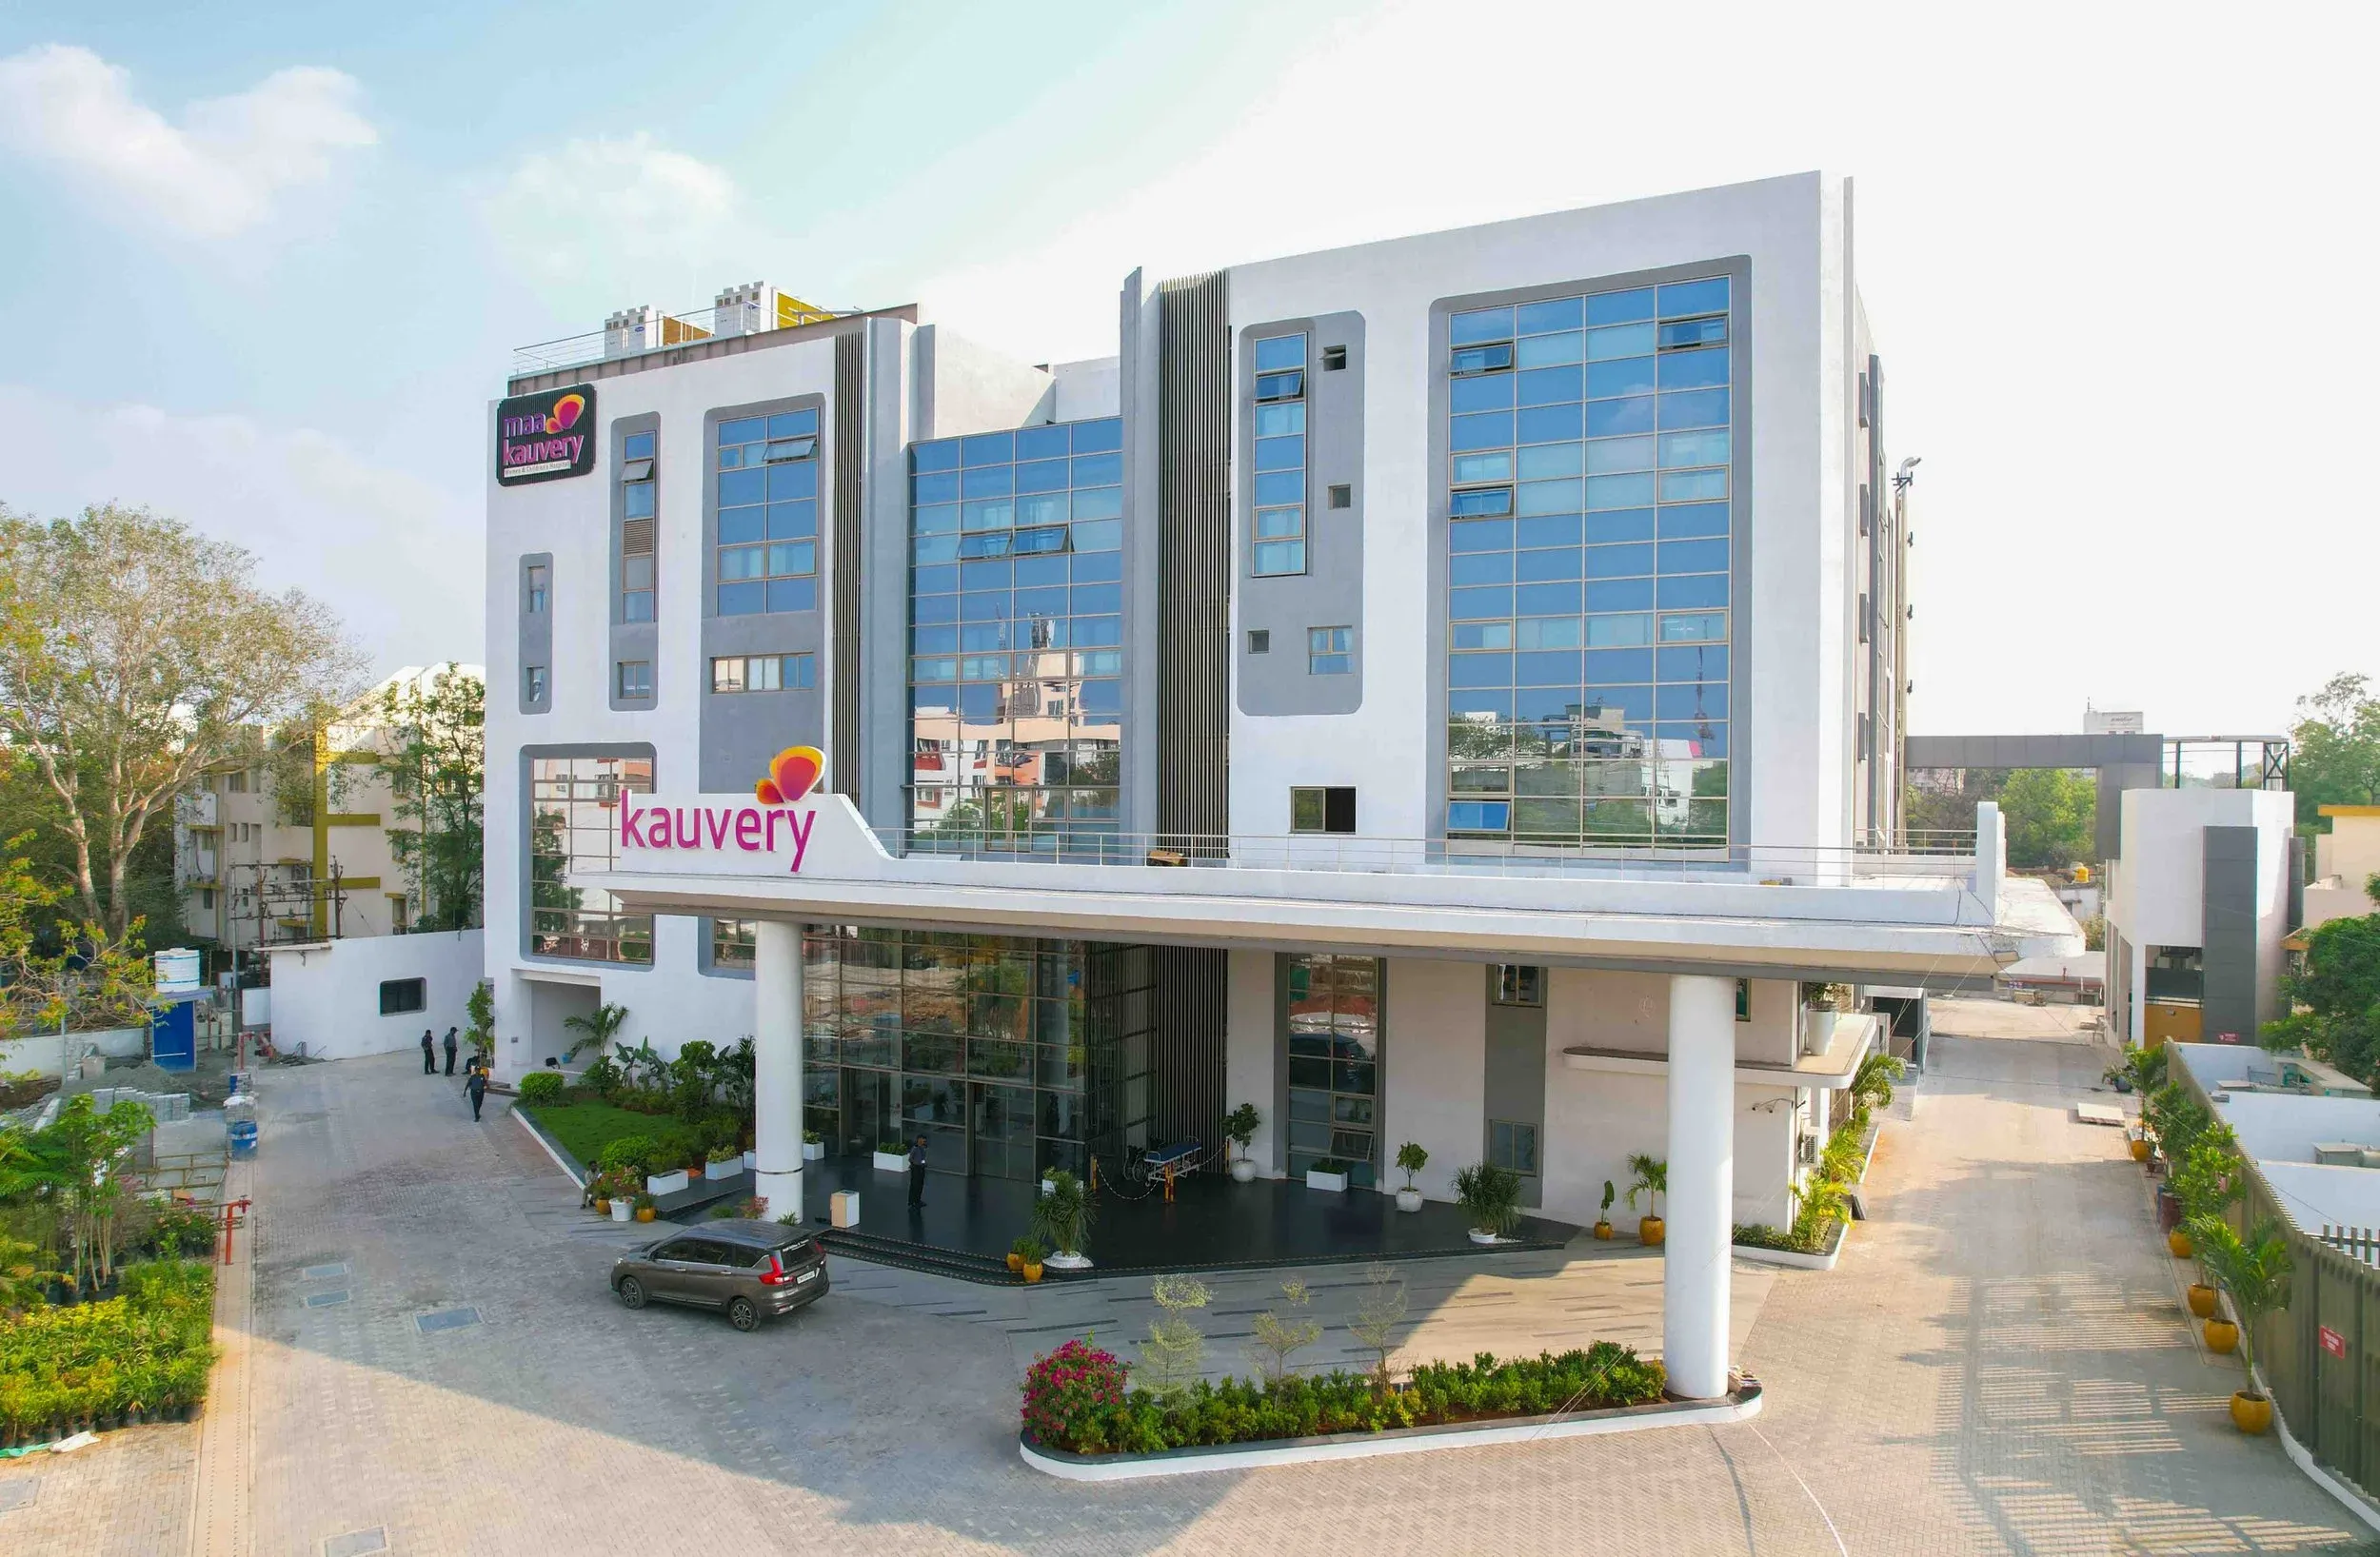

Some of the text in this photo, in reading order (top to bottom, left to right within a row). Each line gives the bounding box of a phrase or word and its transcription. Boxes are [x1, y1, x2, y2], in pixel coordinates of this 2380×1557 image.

[504, 412, 545, 438] maa
[503, 435, 584, 465] kauvery
[621, 789, 816, 873] kauvery
